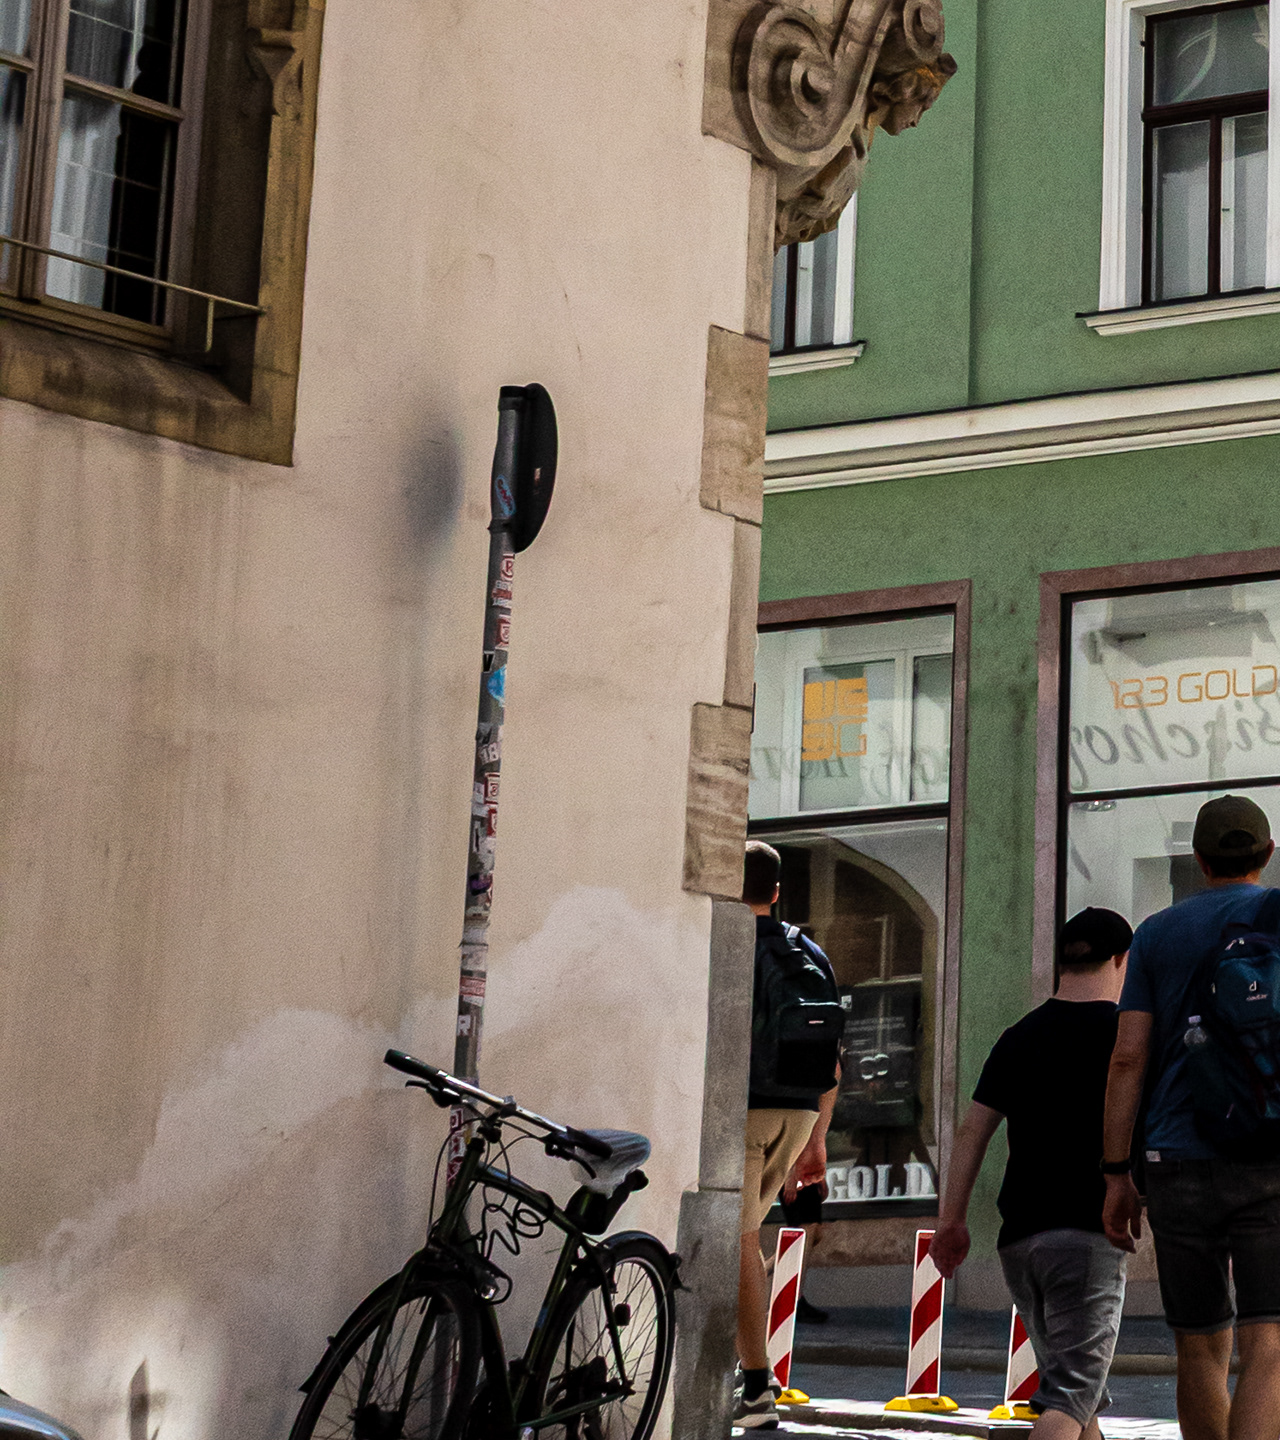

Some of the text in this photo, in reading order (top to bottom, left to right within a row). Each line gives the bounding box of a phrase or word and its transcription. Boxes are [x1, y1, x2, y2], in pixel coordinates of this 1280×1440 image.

[1110, 664, 1278, 709] 123 GOLD
[826, 1162, 934, 1198] GOLD
